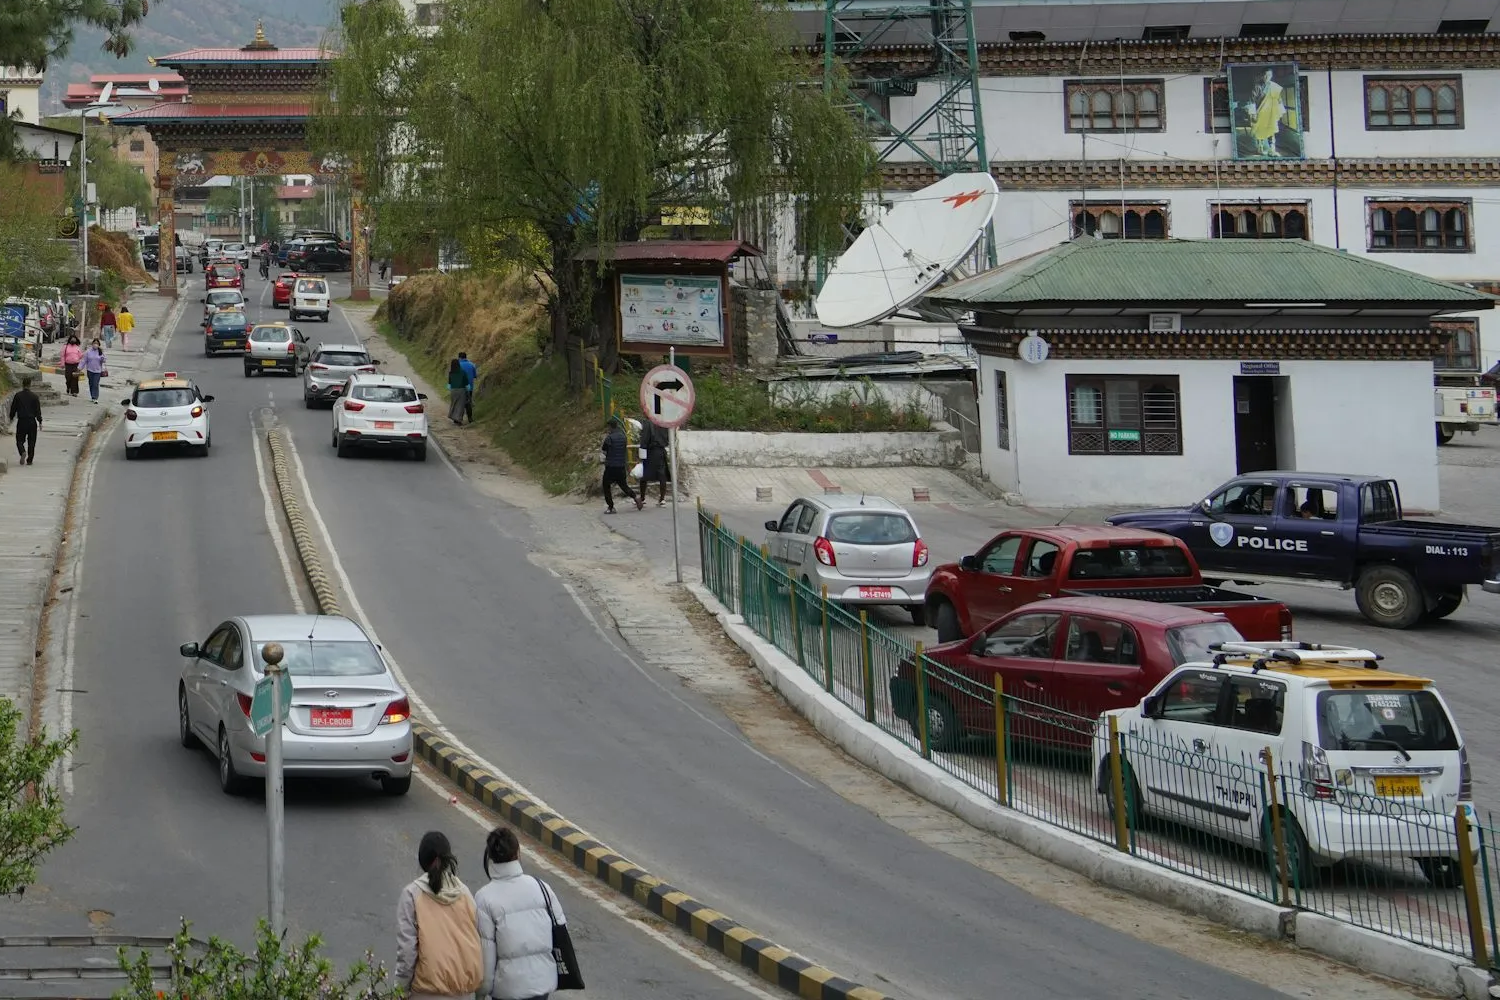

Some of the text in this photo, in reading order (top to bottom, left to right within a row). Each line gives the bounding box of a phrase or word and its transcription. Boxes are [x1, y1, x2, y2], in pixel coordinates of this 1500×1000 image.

[1237, 536, 1308, 552] POLICE
[1425, 545, 1446, 555] DIAL
[1452, 547, 1468, 556] 113
